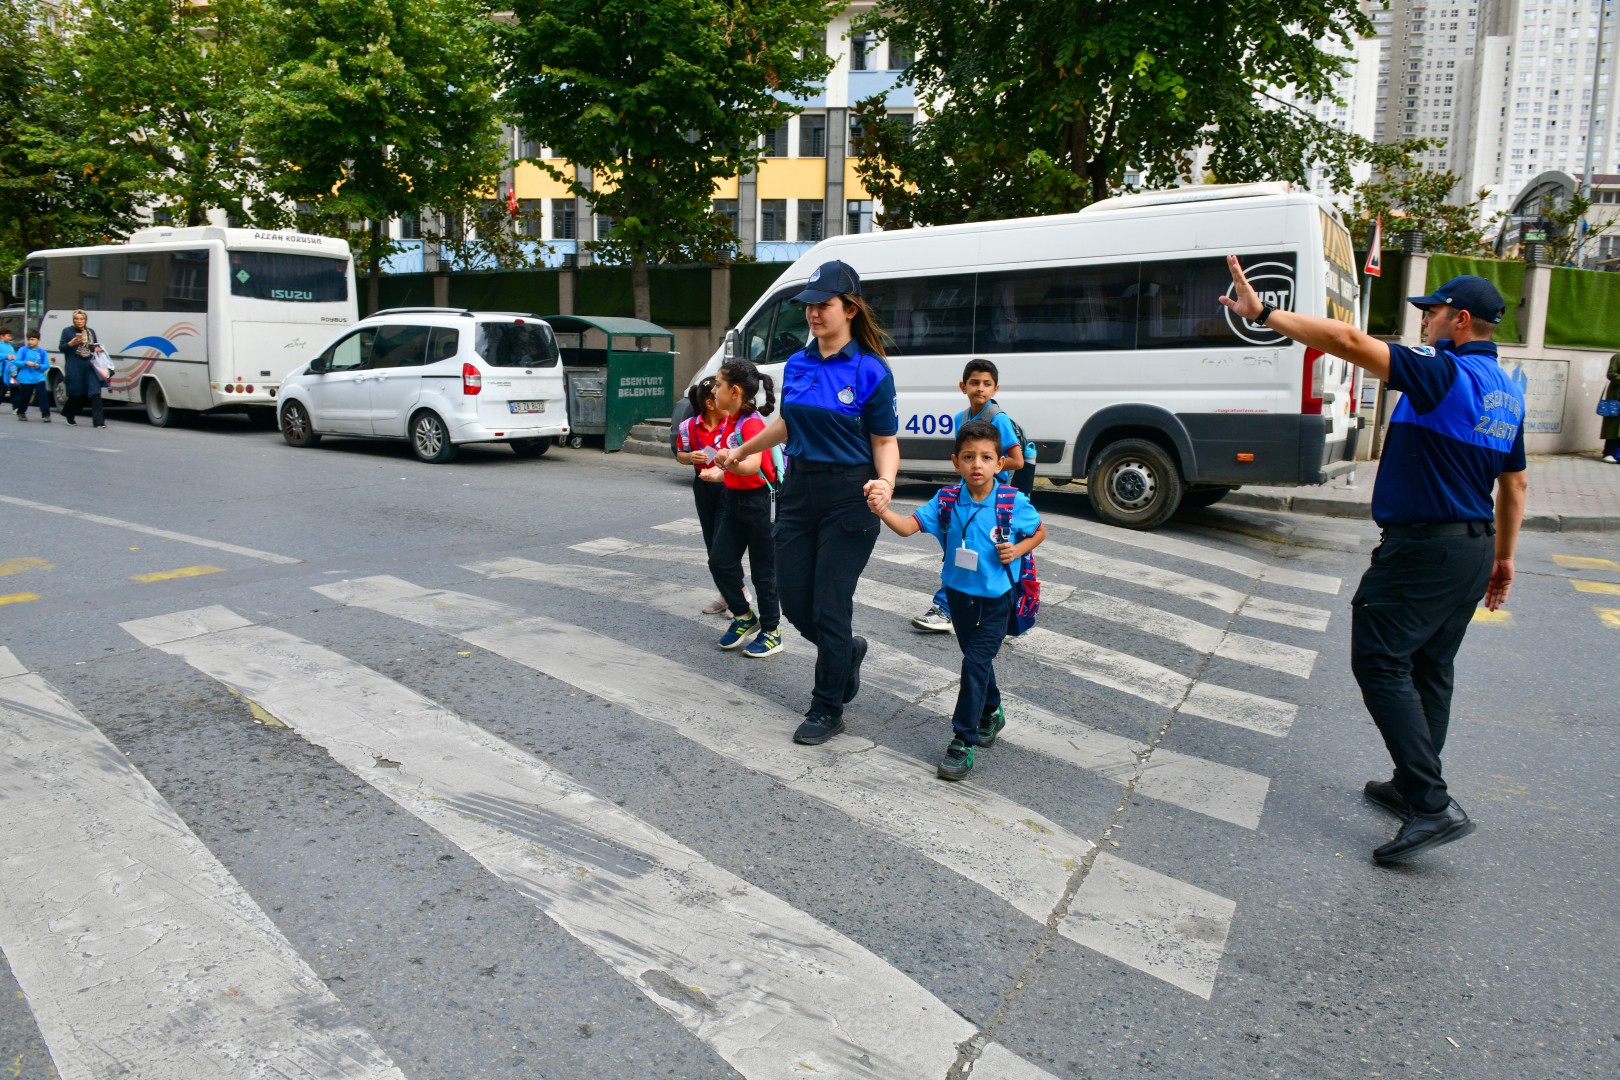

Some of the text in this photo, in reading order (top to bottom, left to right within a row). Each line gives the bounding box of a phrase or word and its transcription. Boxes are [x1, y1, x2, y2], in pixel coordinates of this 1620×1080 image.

[254, 232, 283, 241] ALLAH
[271, 289, 312, 300] ISUZU
[620, 376, 663, 386] ESENYURT
[618, 387, 665, 397] BELEDİYESİ
